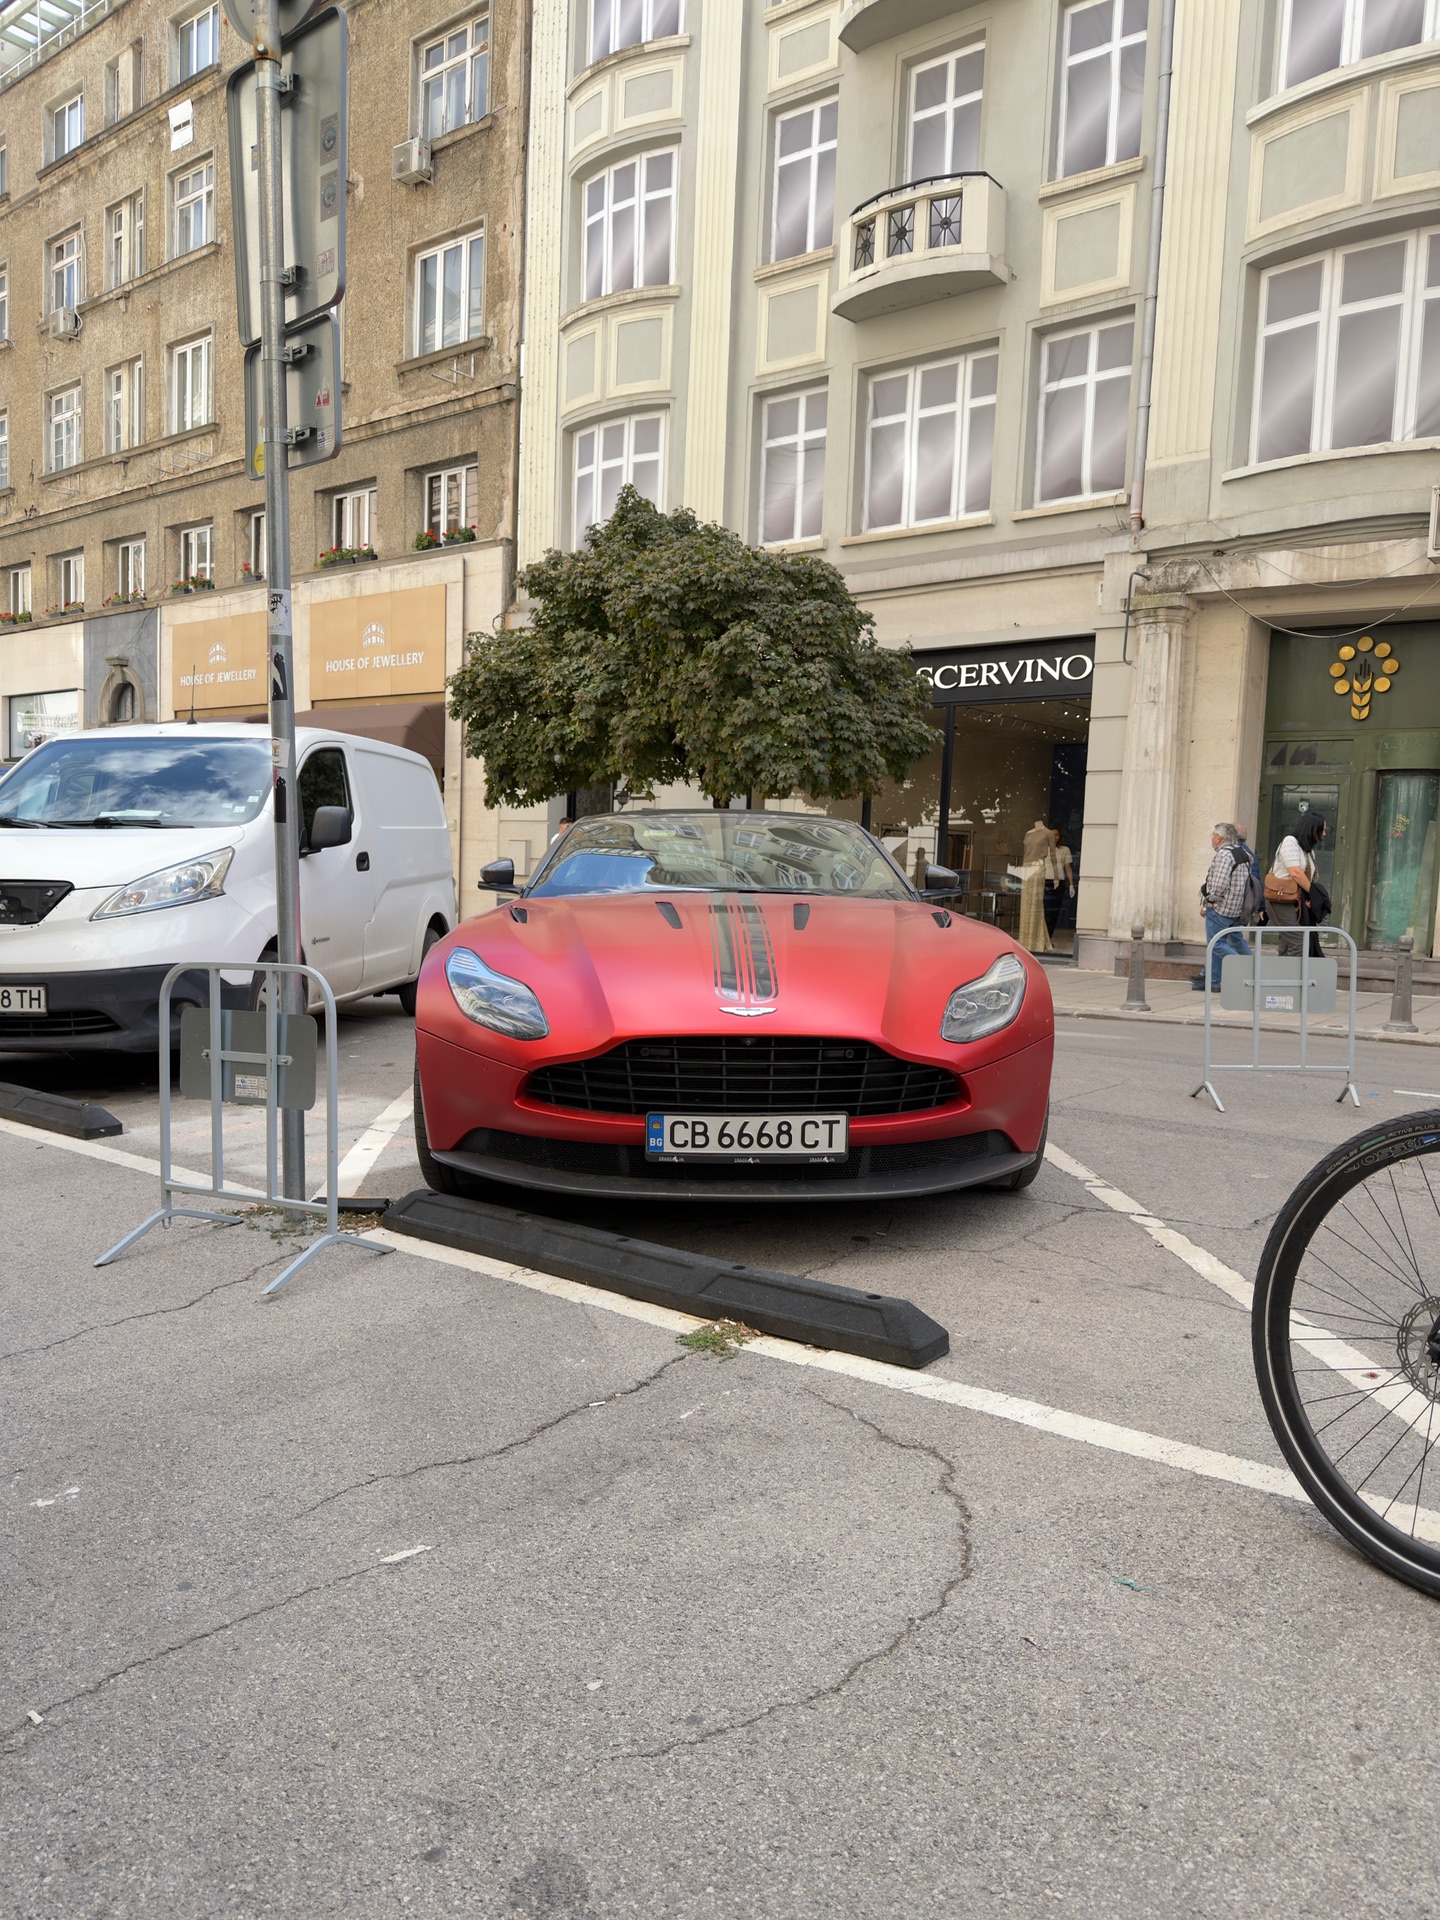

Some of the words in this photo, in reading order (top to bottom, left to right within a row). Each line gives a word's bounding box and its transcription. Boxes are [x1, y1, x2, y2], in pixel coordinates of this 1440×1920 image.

[326, 658, 355, 672] HOUSE
[357, 657, 370, 669] OF
[371, 652, 424, 668] JEWELLERY
[180, 674, 203, 686] HOUSE
[205, 673, 215, 684] OF
[216, 669, 257, 683] JEWELLERY
[16, 989, 41, 1009] TH
[650, 1138, 663, 1147] BG
[669, 1120, 710, 1148] CB
[717, 1120, 793, 1149] 6668
[800, 1119, 841, 1149] CT
[1326, 1148, 1358, 1174] SCHWALBE
